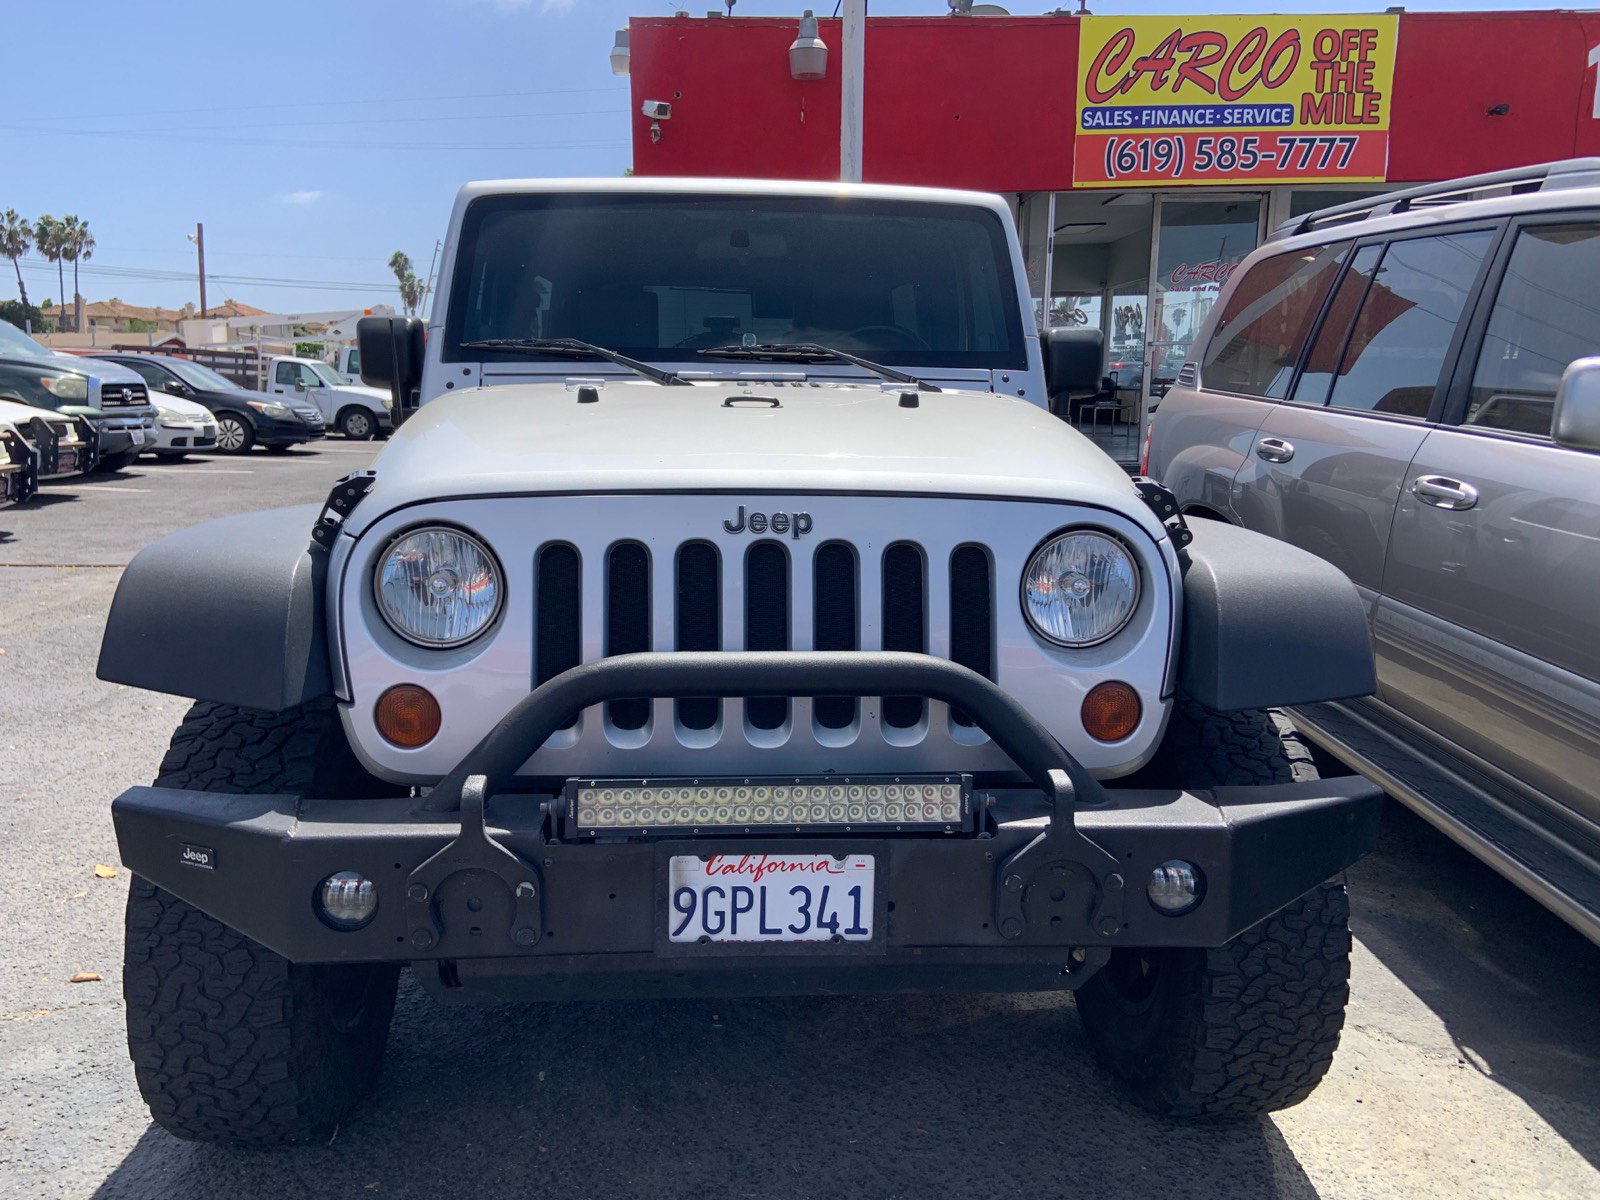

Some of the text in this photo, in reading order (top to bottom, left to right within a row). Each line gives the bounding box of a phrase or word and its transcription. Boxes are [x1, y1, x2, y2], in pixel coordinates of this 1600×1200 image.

[1313, 29, 1378, 62] OFF
[1085, 27, 1301, 104] CARCO
[1310, 61, 1375, 93] THE
[1083, 107, 1291, 127] SALES FINANCE SERVICE
[1299, 92, 1382, 125] MILE
[1104, 135, 1359, 179] (619) 585-7777
[723, 504, 813, 540] Jeep
[183, 848, 208, 864] Jeep
[705, 854, 845, 883] California
[672, 885, 869, 936] 9GPL341
